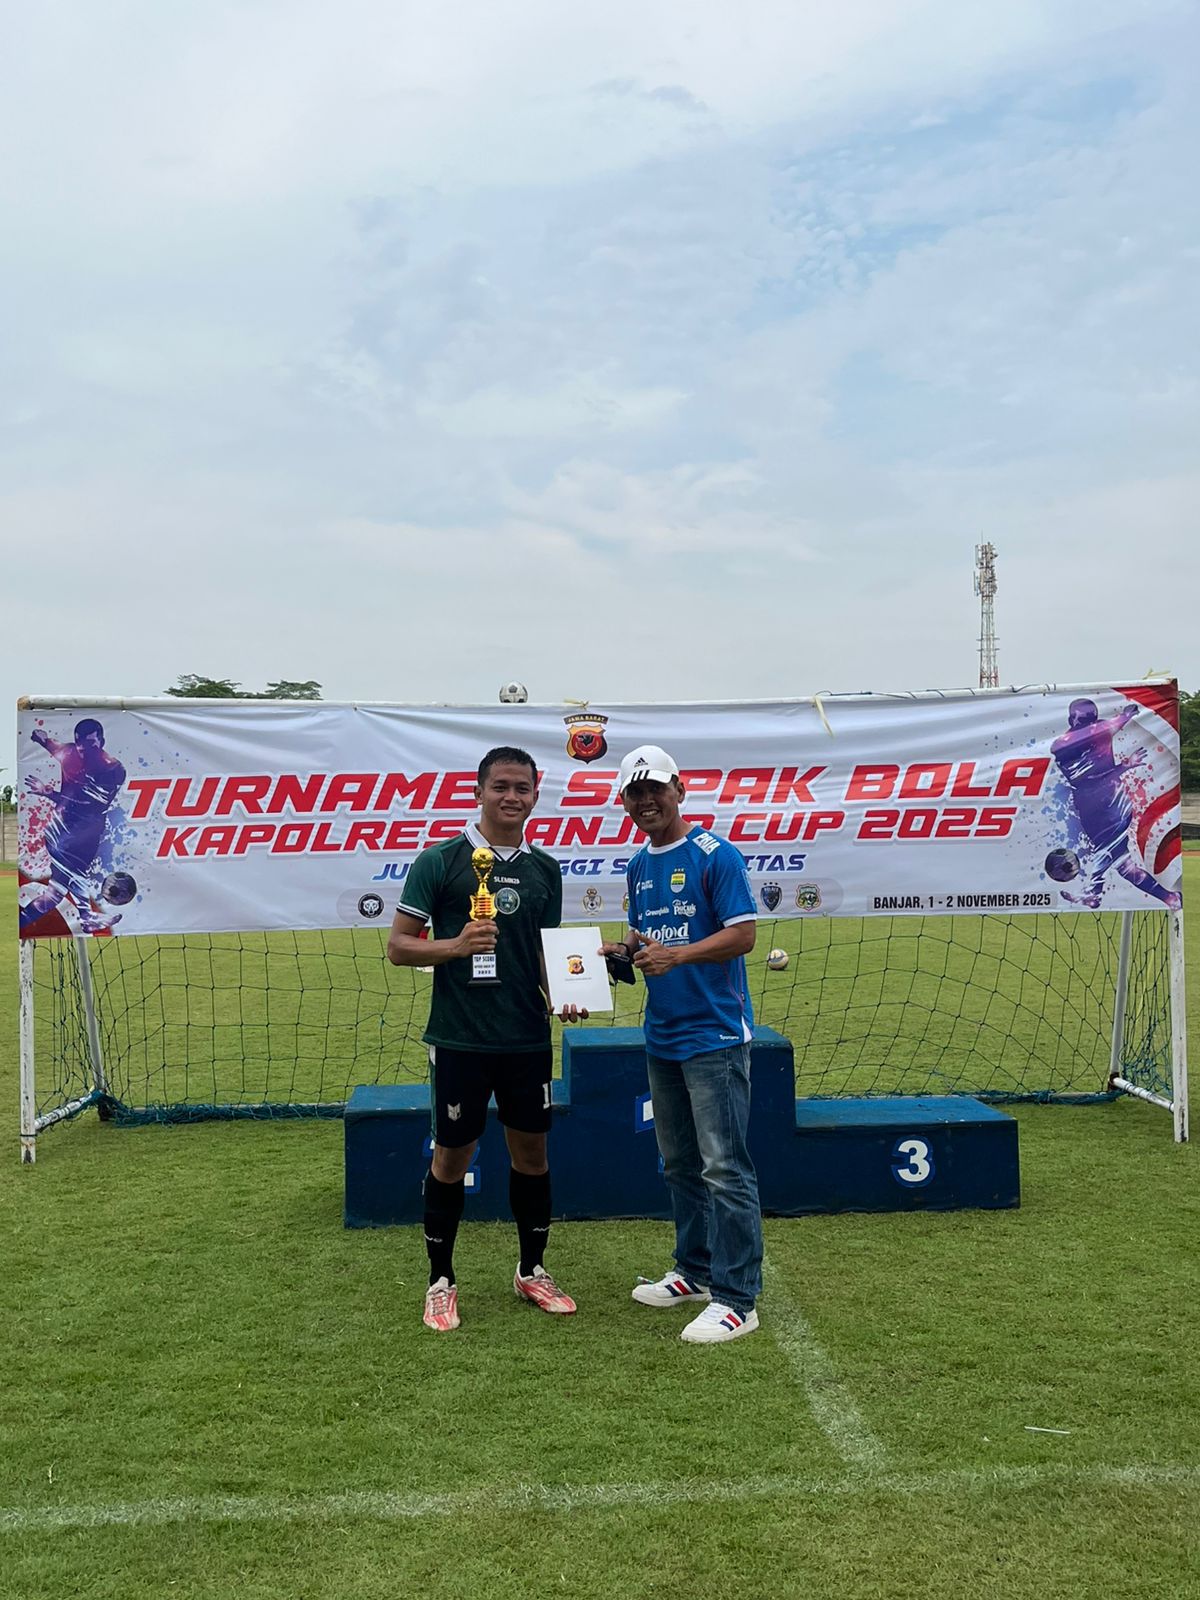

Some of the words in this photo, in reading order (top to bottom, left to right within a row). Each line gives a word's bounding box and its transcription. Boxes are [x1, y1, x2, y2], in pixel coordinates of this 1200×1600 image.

[127, 770, 544, 818] TURNAME
[560, 766, 828, 807] SPAK
[845, 757, 1052, 801] BOLA
[156, 819, 467, 857] KAPOLRES
[728, 811, 846, 842] CUP
[857, 807, 1018, 839] 2025
[873, 896, 924, 909] BANJAR,
[928, 896, 934, 908] 1
[946, 896, 954, 908] 2
[957, 895, 1020, 908] NOVEMBER
[1022, 894, 1051, 907] 2025
[898, 1140, 930, 1182] 3
